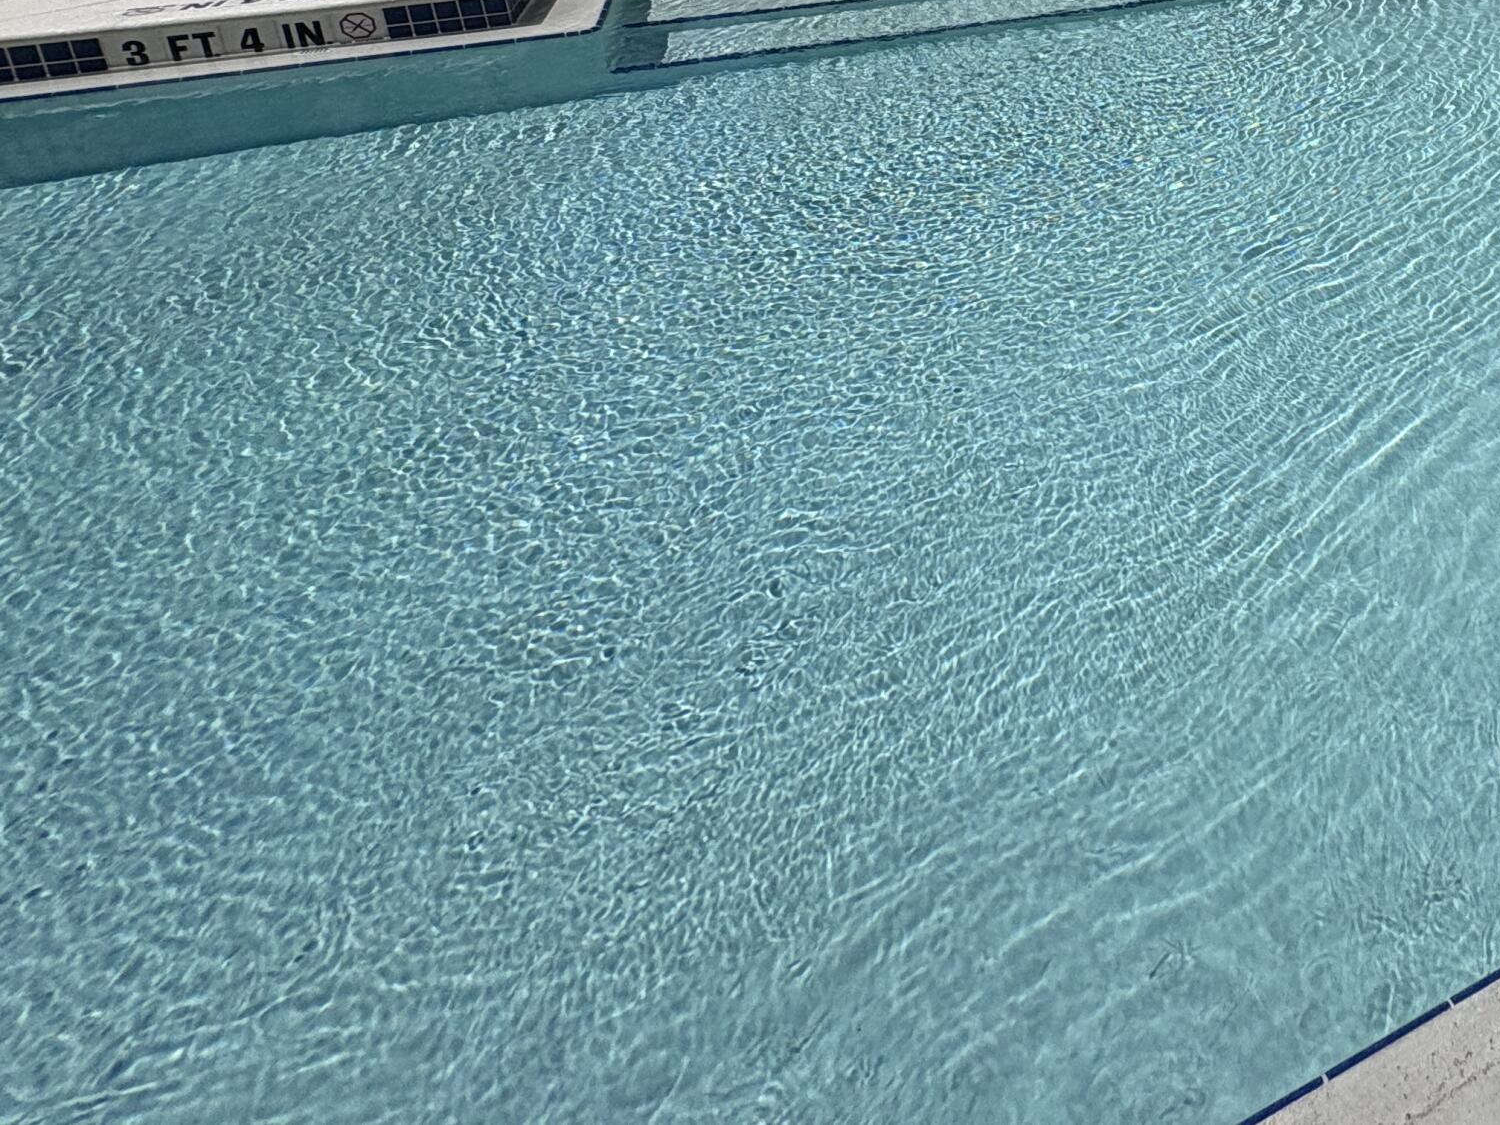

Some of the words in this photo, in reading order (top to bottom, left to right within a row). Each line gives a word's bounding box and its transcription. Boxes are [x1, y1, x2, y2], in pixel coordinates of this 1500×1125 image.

[122, 40, 150, 66] 3
[166, 31, 221, 62] FT.
[240, 27, 265, 52] 4
[281, 20, 333, 49] IN.
